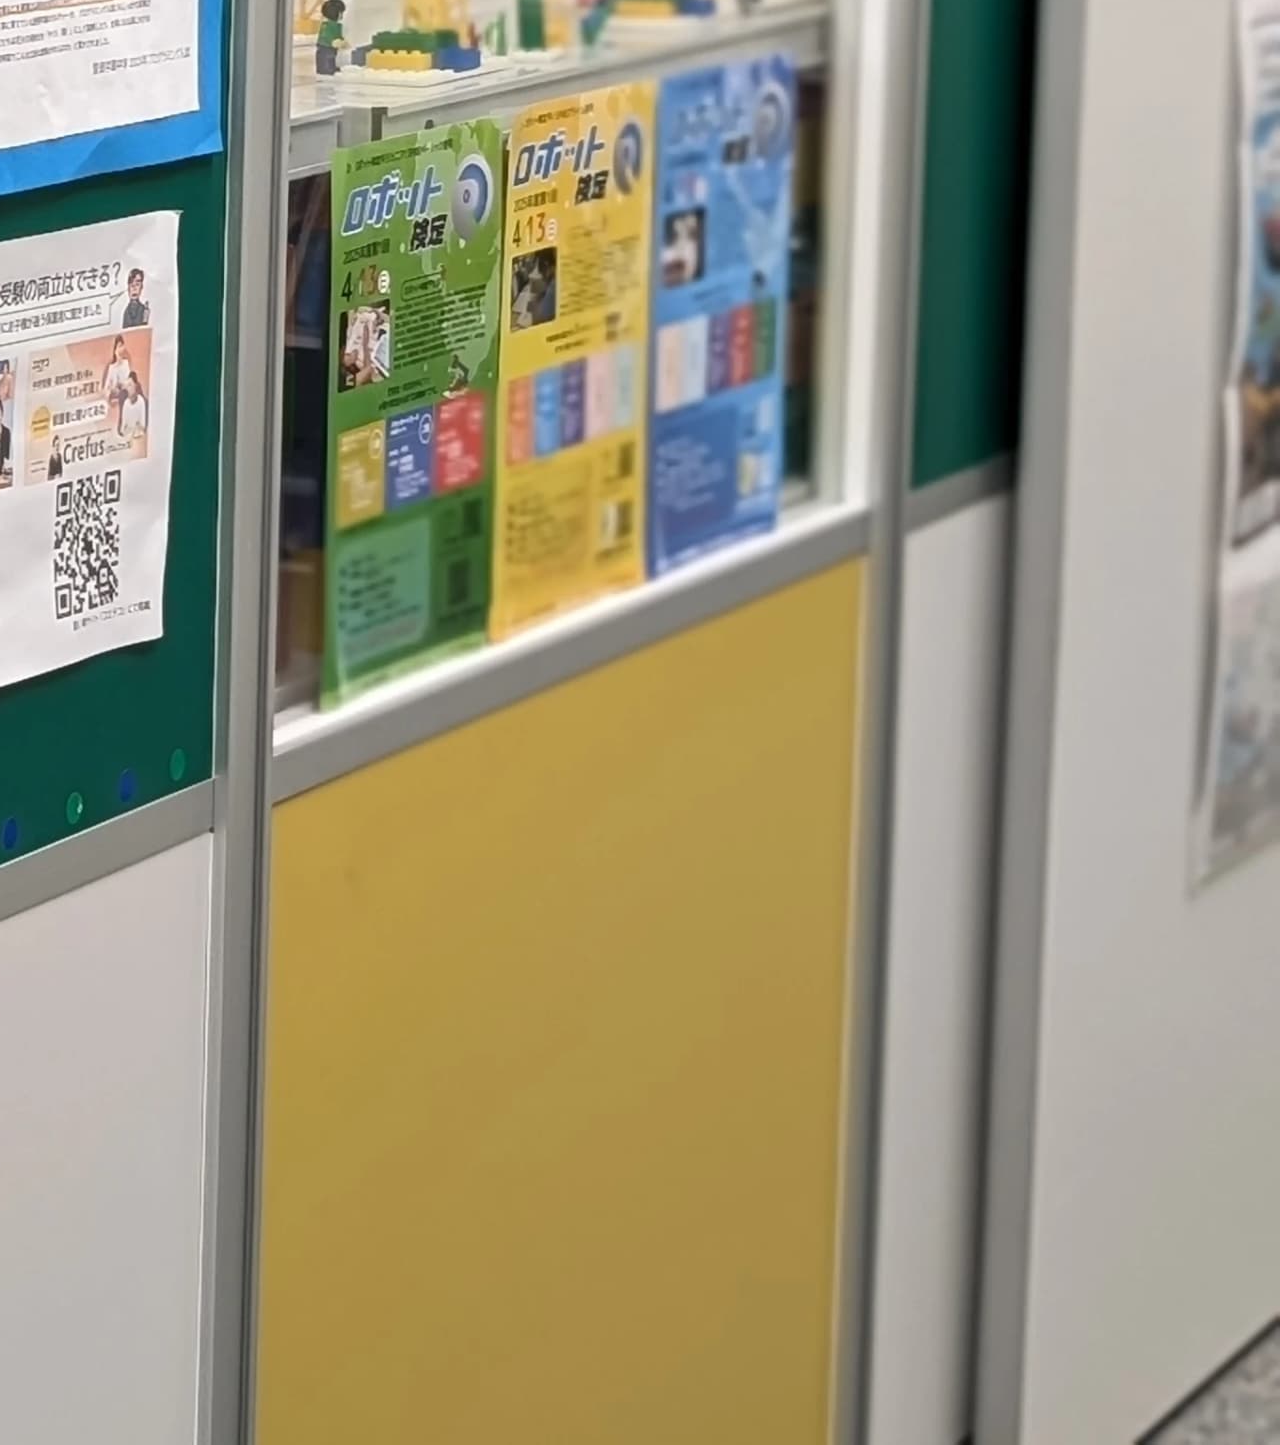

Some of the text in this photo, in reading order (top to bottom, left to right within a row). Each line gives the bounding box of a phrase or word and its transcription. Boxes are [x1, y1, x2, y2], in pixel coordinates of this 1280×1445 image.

[513, 124, 606, 187] ロボット
[341, 164, 445, 237] ロボット
[574, 170, 610, 205] 検定
[410, 214, 449, 253] 検定
[63, 436, 105, 465] Crefus
